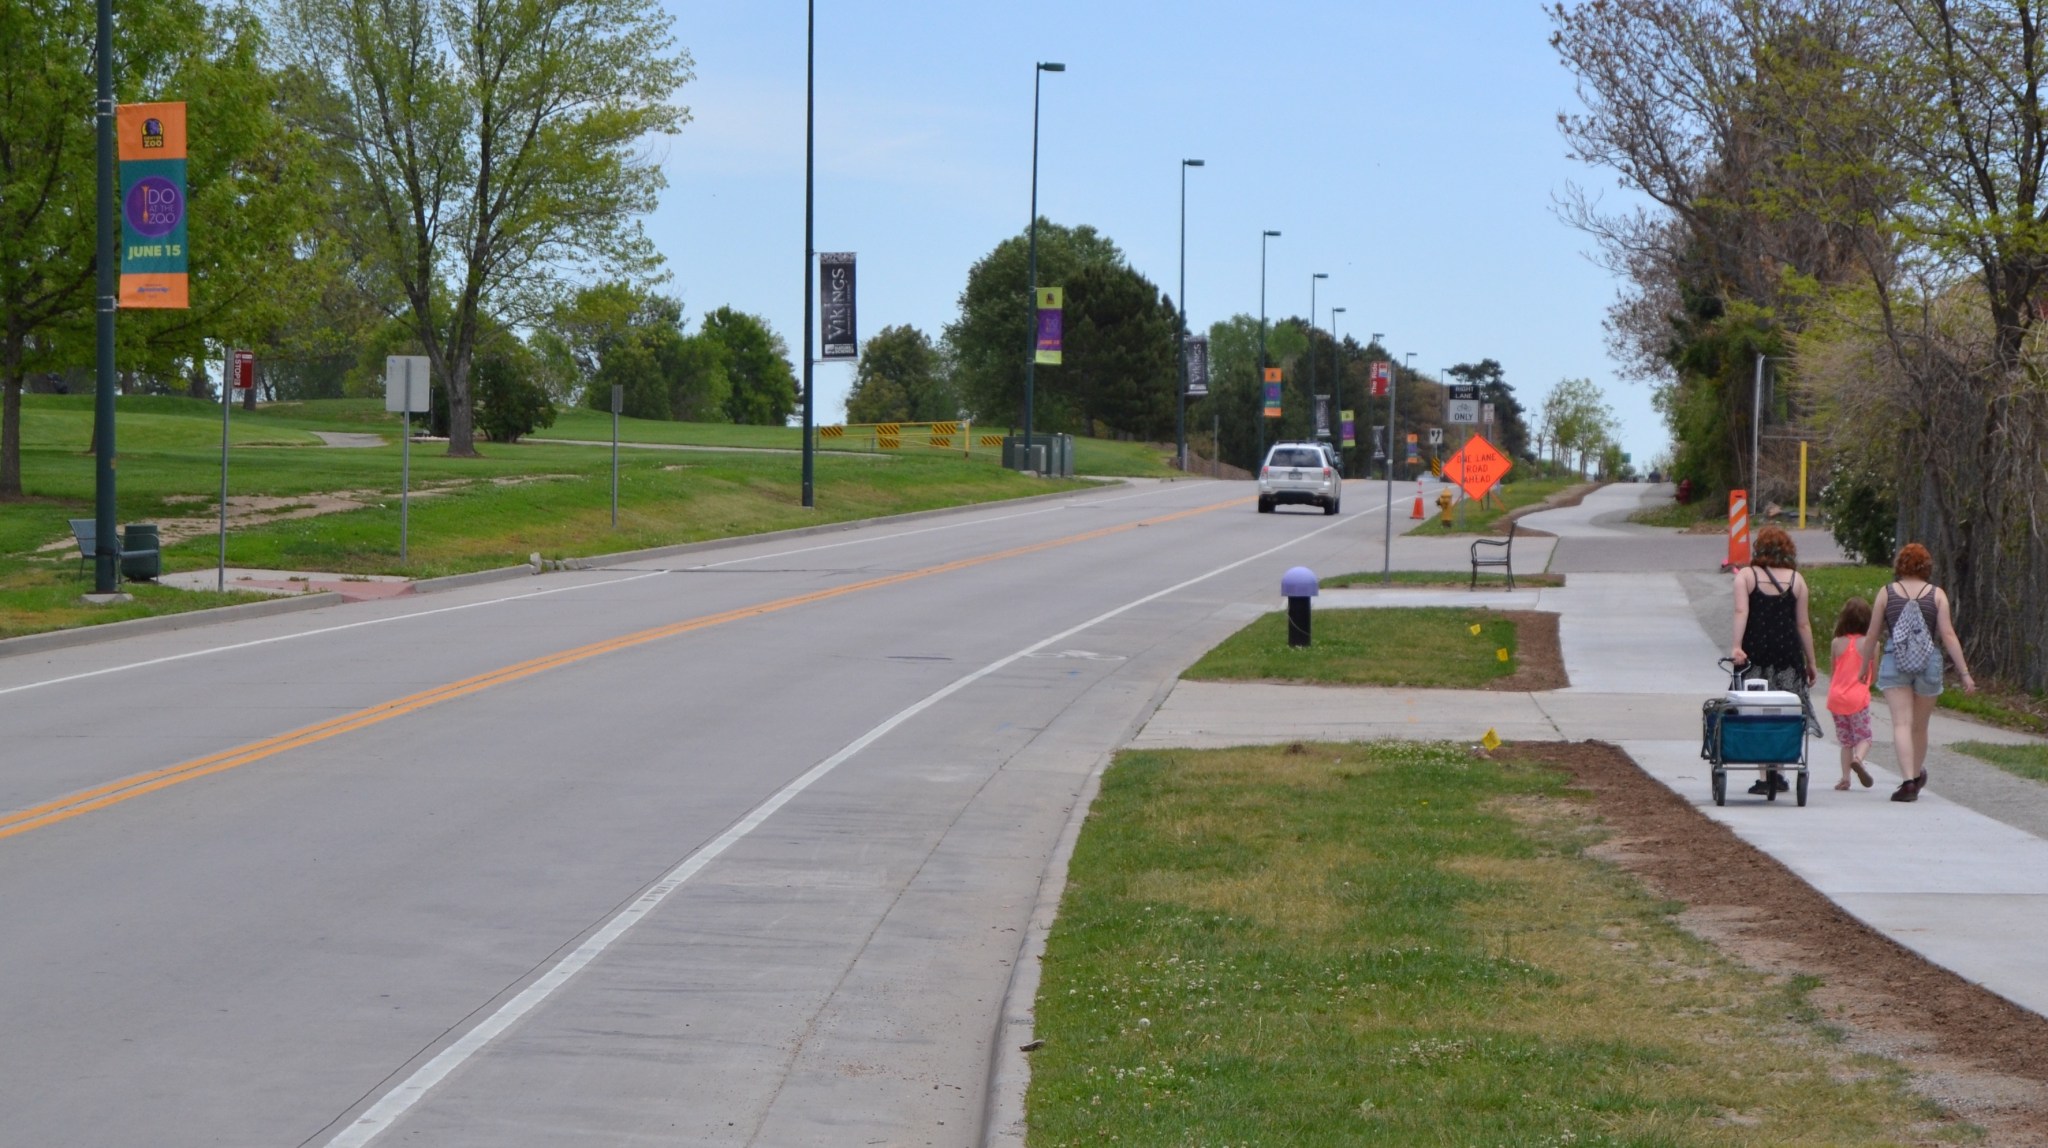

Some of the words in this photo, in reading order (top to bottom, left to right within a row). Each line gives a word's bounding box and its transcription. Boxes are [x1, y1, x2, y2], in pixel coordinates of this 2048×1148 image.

[144, 140, 162, 148] ZOO
[149, 188, 175, 205] DO
[149, 212, 176, 224] ZOO
[128, 246, 162, 260] JUNE
[166, 245, 181, 256] 15
[825, 268, 846, 340] VIKINGS
[1476, 454, 1496, 462] LANE
[1466, 464, 1488, 473] ROAD
[1464, 475, 1490, 483] AHEAD
